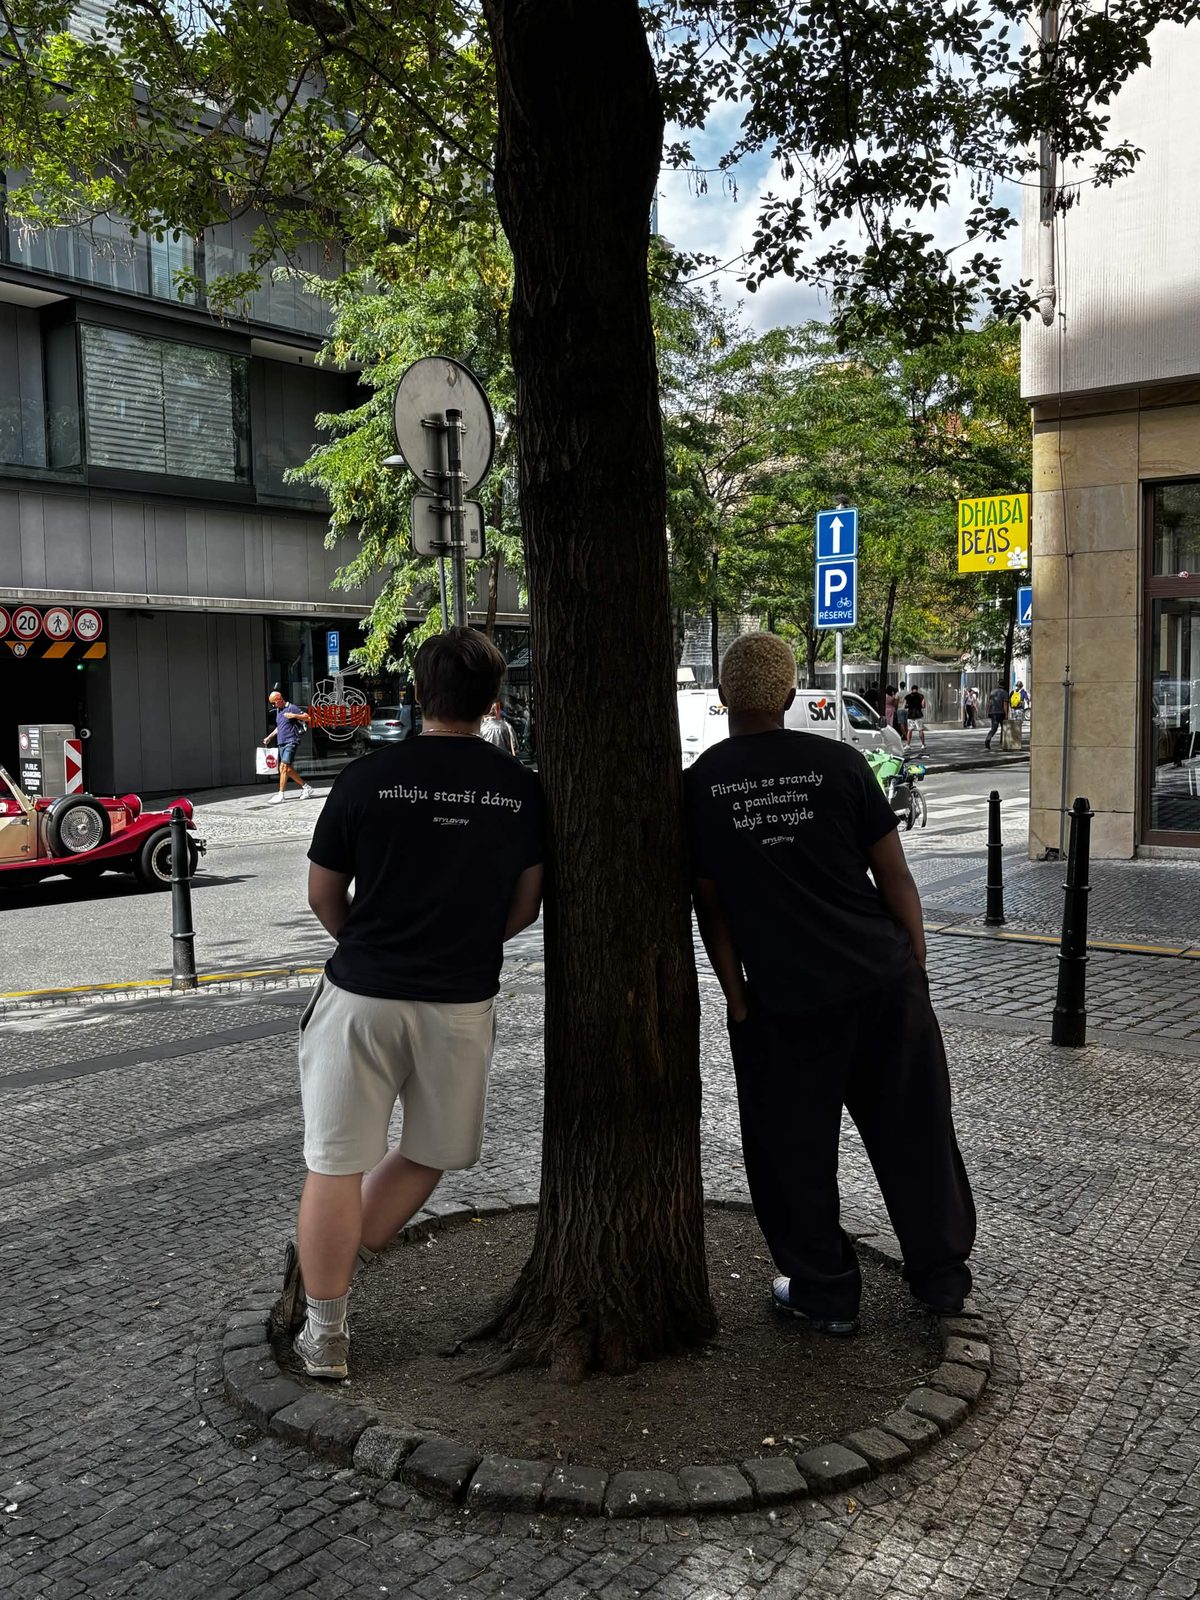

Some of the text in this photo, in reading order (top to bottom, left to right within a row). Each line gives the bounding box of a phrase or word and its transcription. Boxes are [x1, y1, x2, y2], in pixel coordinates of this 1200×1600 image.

[961, 498, 1023, 528] DHABA
[961, 527, 1010, 555] BEAS
[824, 568, 847, 607] P
[18, 615, 36, 630] 20
[711, 770, 823, 797] Flirtuju ze srandy
[378, 785, 522, 813] miluju starší dámy
[732, 790, 808, 812] a panikařím
[733, 807, 814, 830] když to vyjde
